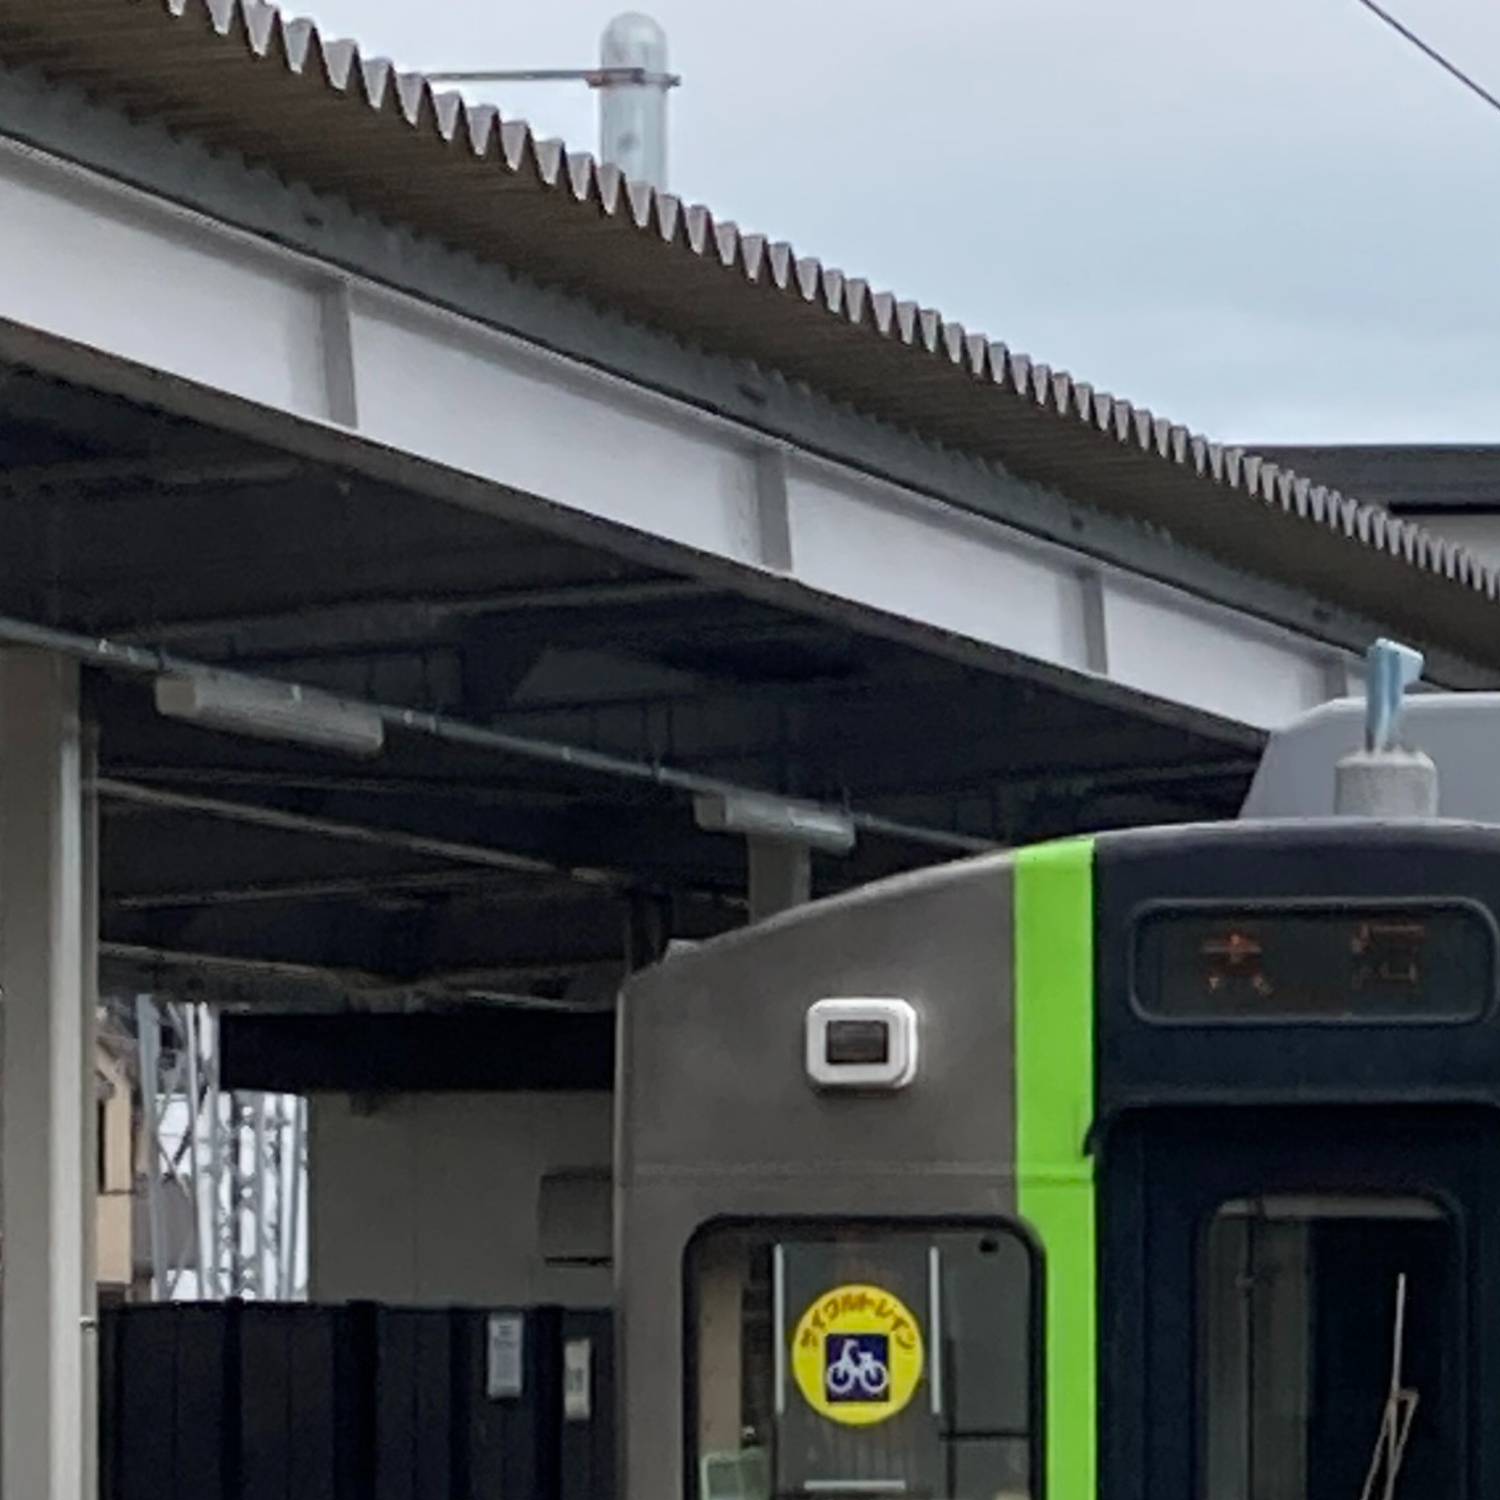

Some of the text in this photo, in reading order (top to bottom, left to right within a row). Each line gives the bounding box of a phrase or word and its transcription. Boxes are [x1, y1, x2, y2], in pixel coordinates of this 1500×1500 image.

[799, 1291, 916, 1350] サイクルトレイン
